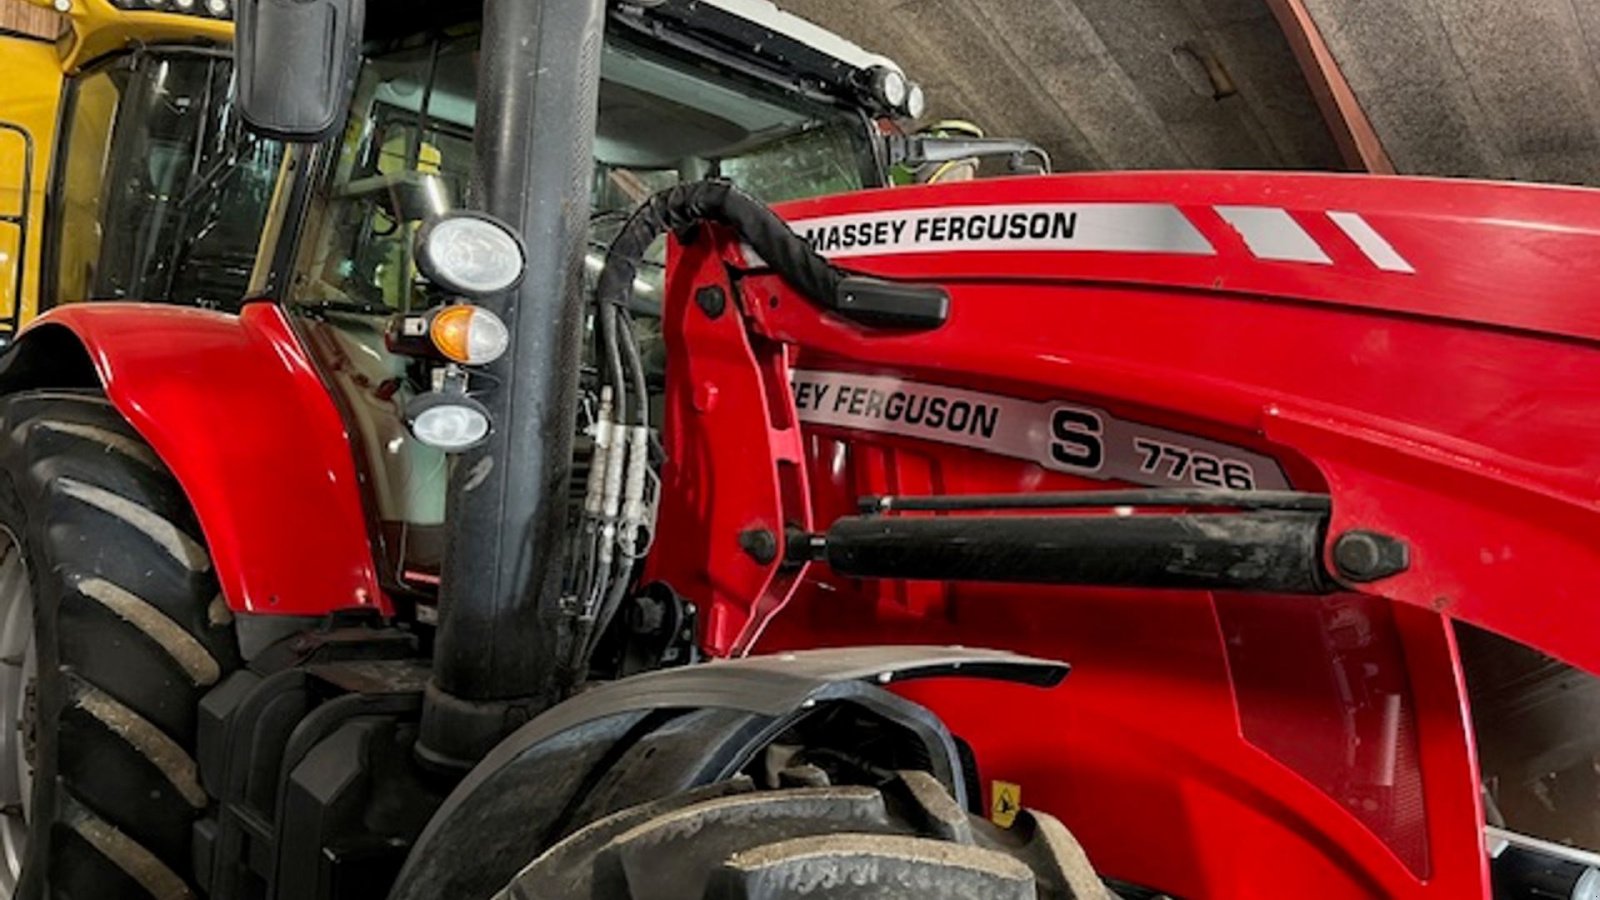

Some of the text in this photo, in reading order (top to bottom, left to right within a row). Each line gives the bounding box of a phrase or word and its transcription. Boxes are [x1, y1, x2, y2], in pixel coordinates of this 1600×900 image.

[807, 212, 1077, 250] MASSEY FERGUSON
[833, 387, 999, 438] FERGUSON
[1051, 408, 1101, 470] S
[1135, 439, 1253, 491] 7726
